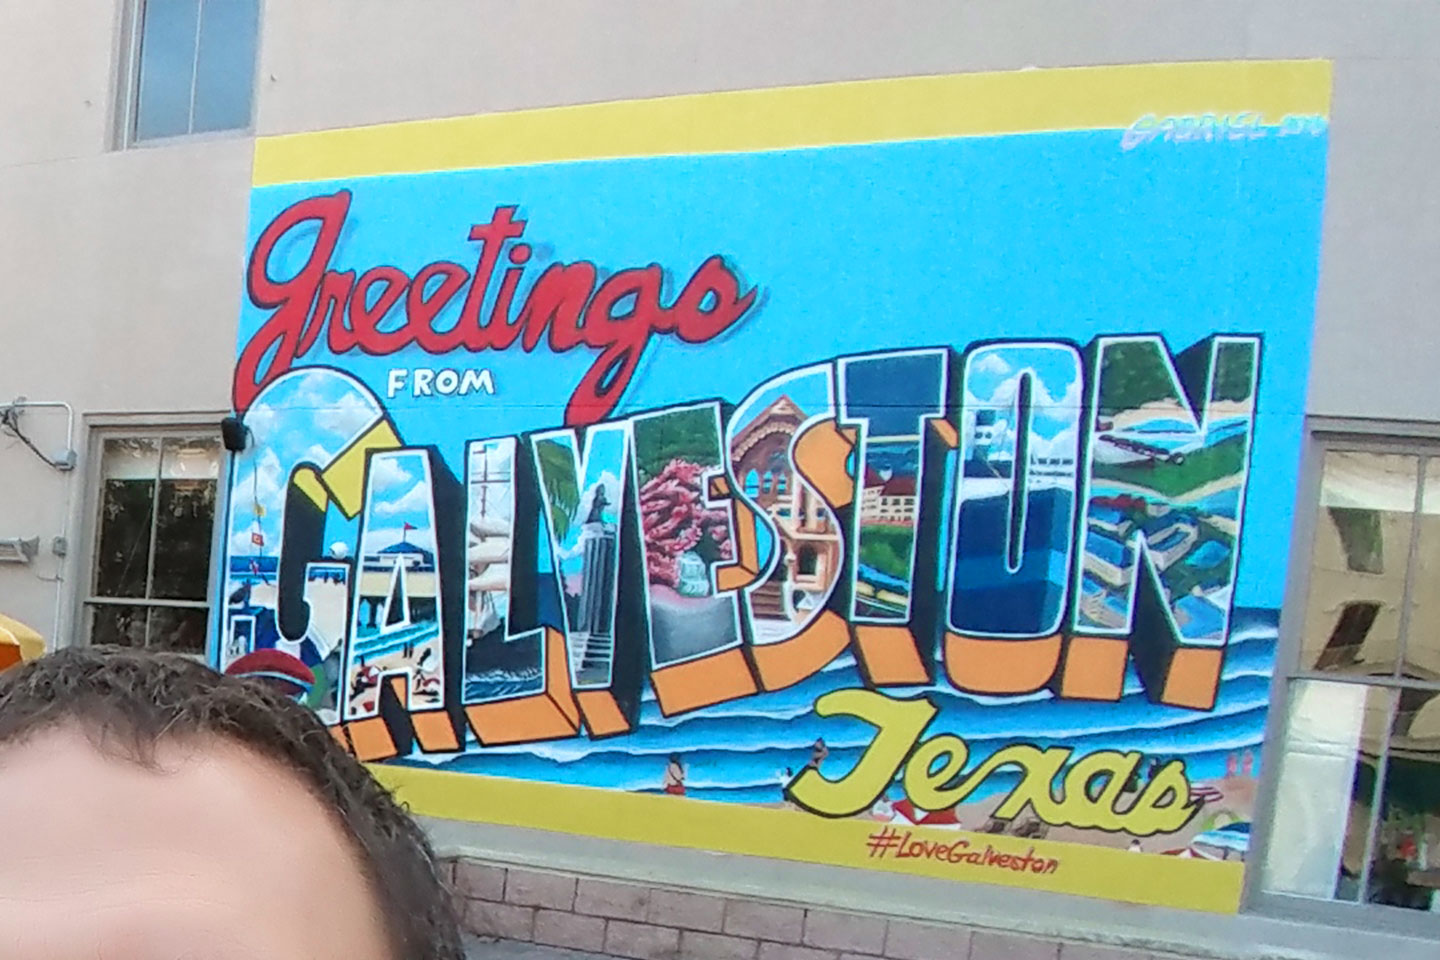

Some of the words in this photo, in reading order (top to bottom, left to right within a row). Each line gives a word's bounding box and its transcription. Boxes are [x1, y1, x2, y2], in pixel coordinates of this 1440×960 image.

[232, 188, 759, 428] Greetings
[386, 367, 496, 397] FROM
[220, 333, 1265, 762] GALVESTON
[782, 687, 1205, 836] Texas
[865, 825, 1060, 875] #LoveGalveston
